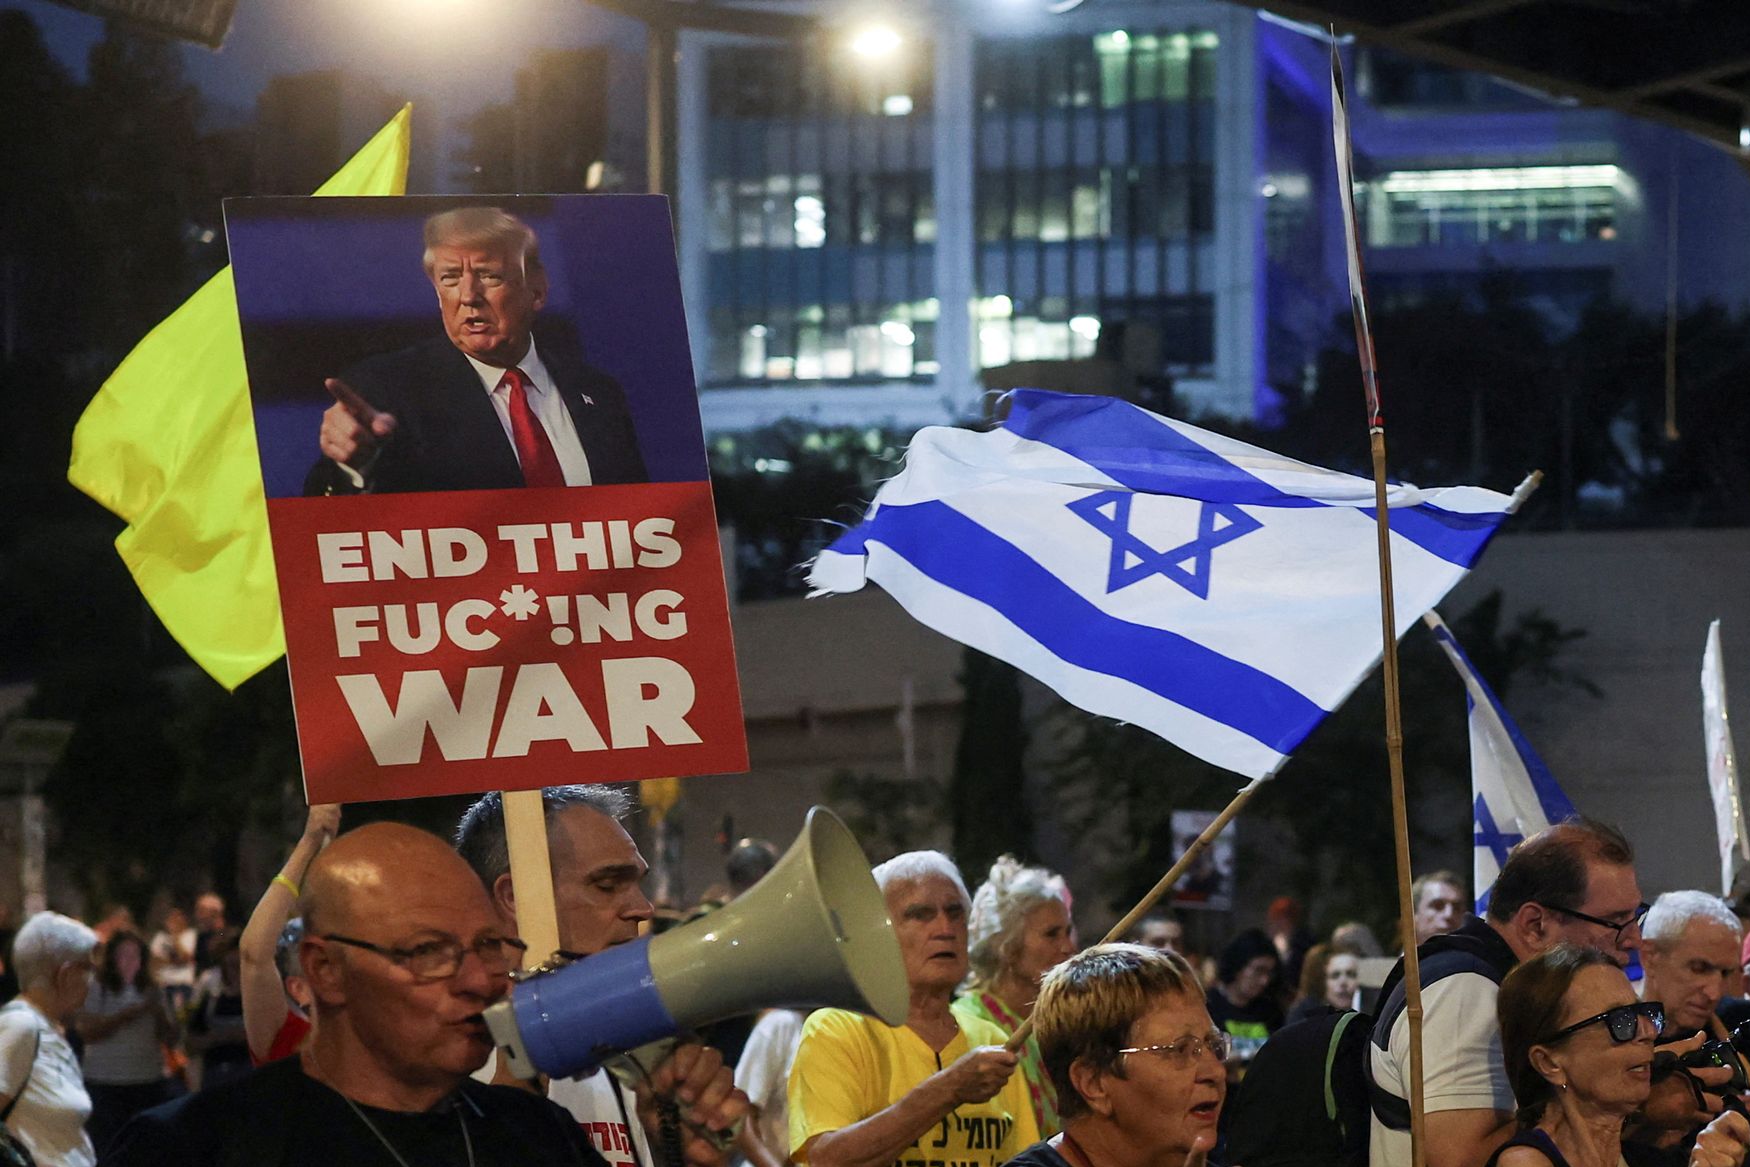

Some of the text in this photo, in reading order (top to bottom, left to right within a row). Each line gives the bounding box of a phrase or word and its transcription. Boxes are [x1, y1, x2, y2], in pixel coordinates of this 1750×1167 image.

[316, 517, 682, 584] END THIS
[335, 656, 704, 767] WAR
